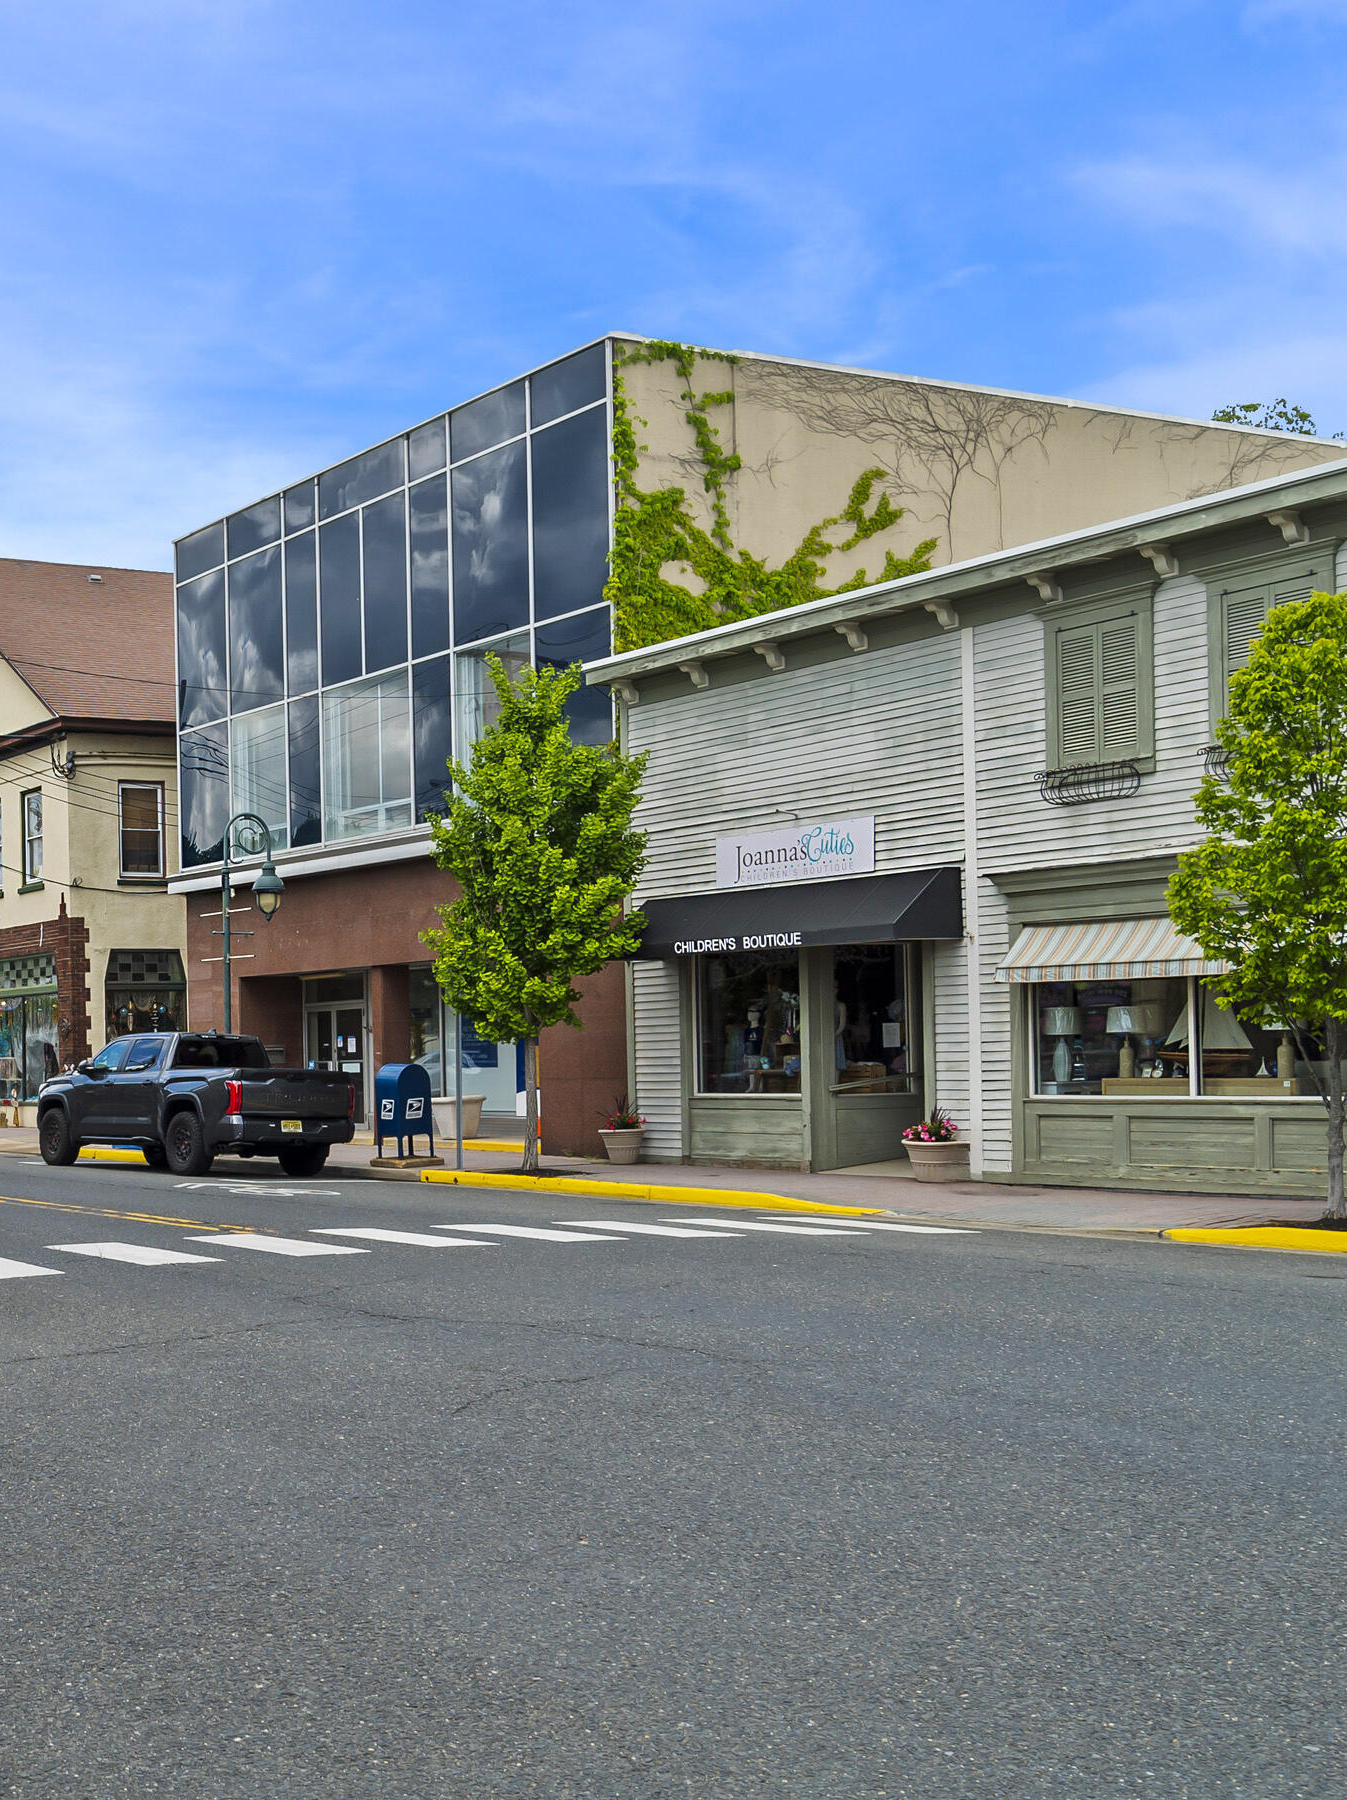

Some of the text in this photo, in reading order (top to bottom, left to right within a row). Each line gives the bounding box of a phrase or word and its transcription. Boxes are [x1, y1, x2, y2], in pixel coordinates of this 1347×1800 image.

[734, 826, 855, 884] Joanna's Cuties
[740, 862, 854, 883] CHILDREN'S BOUTIQUE
[674, 932, 802, 954] CHILDREN'S BOUTIQUE
